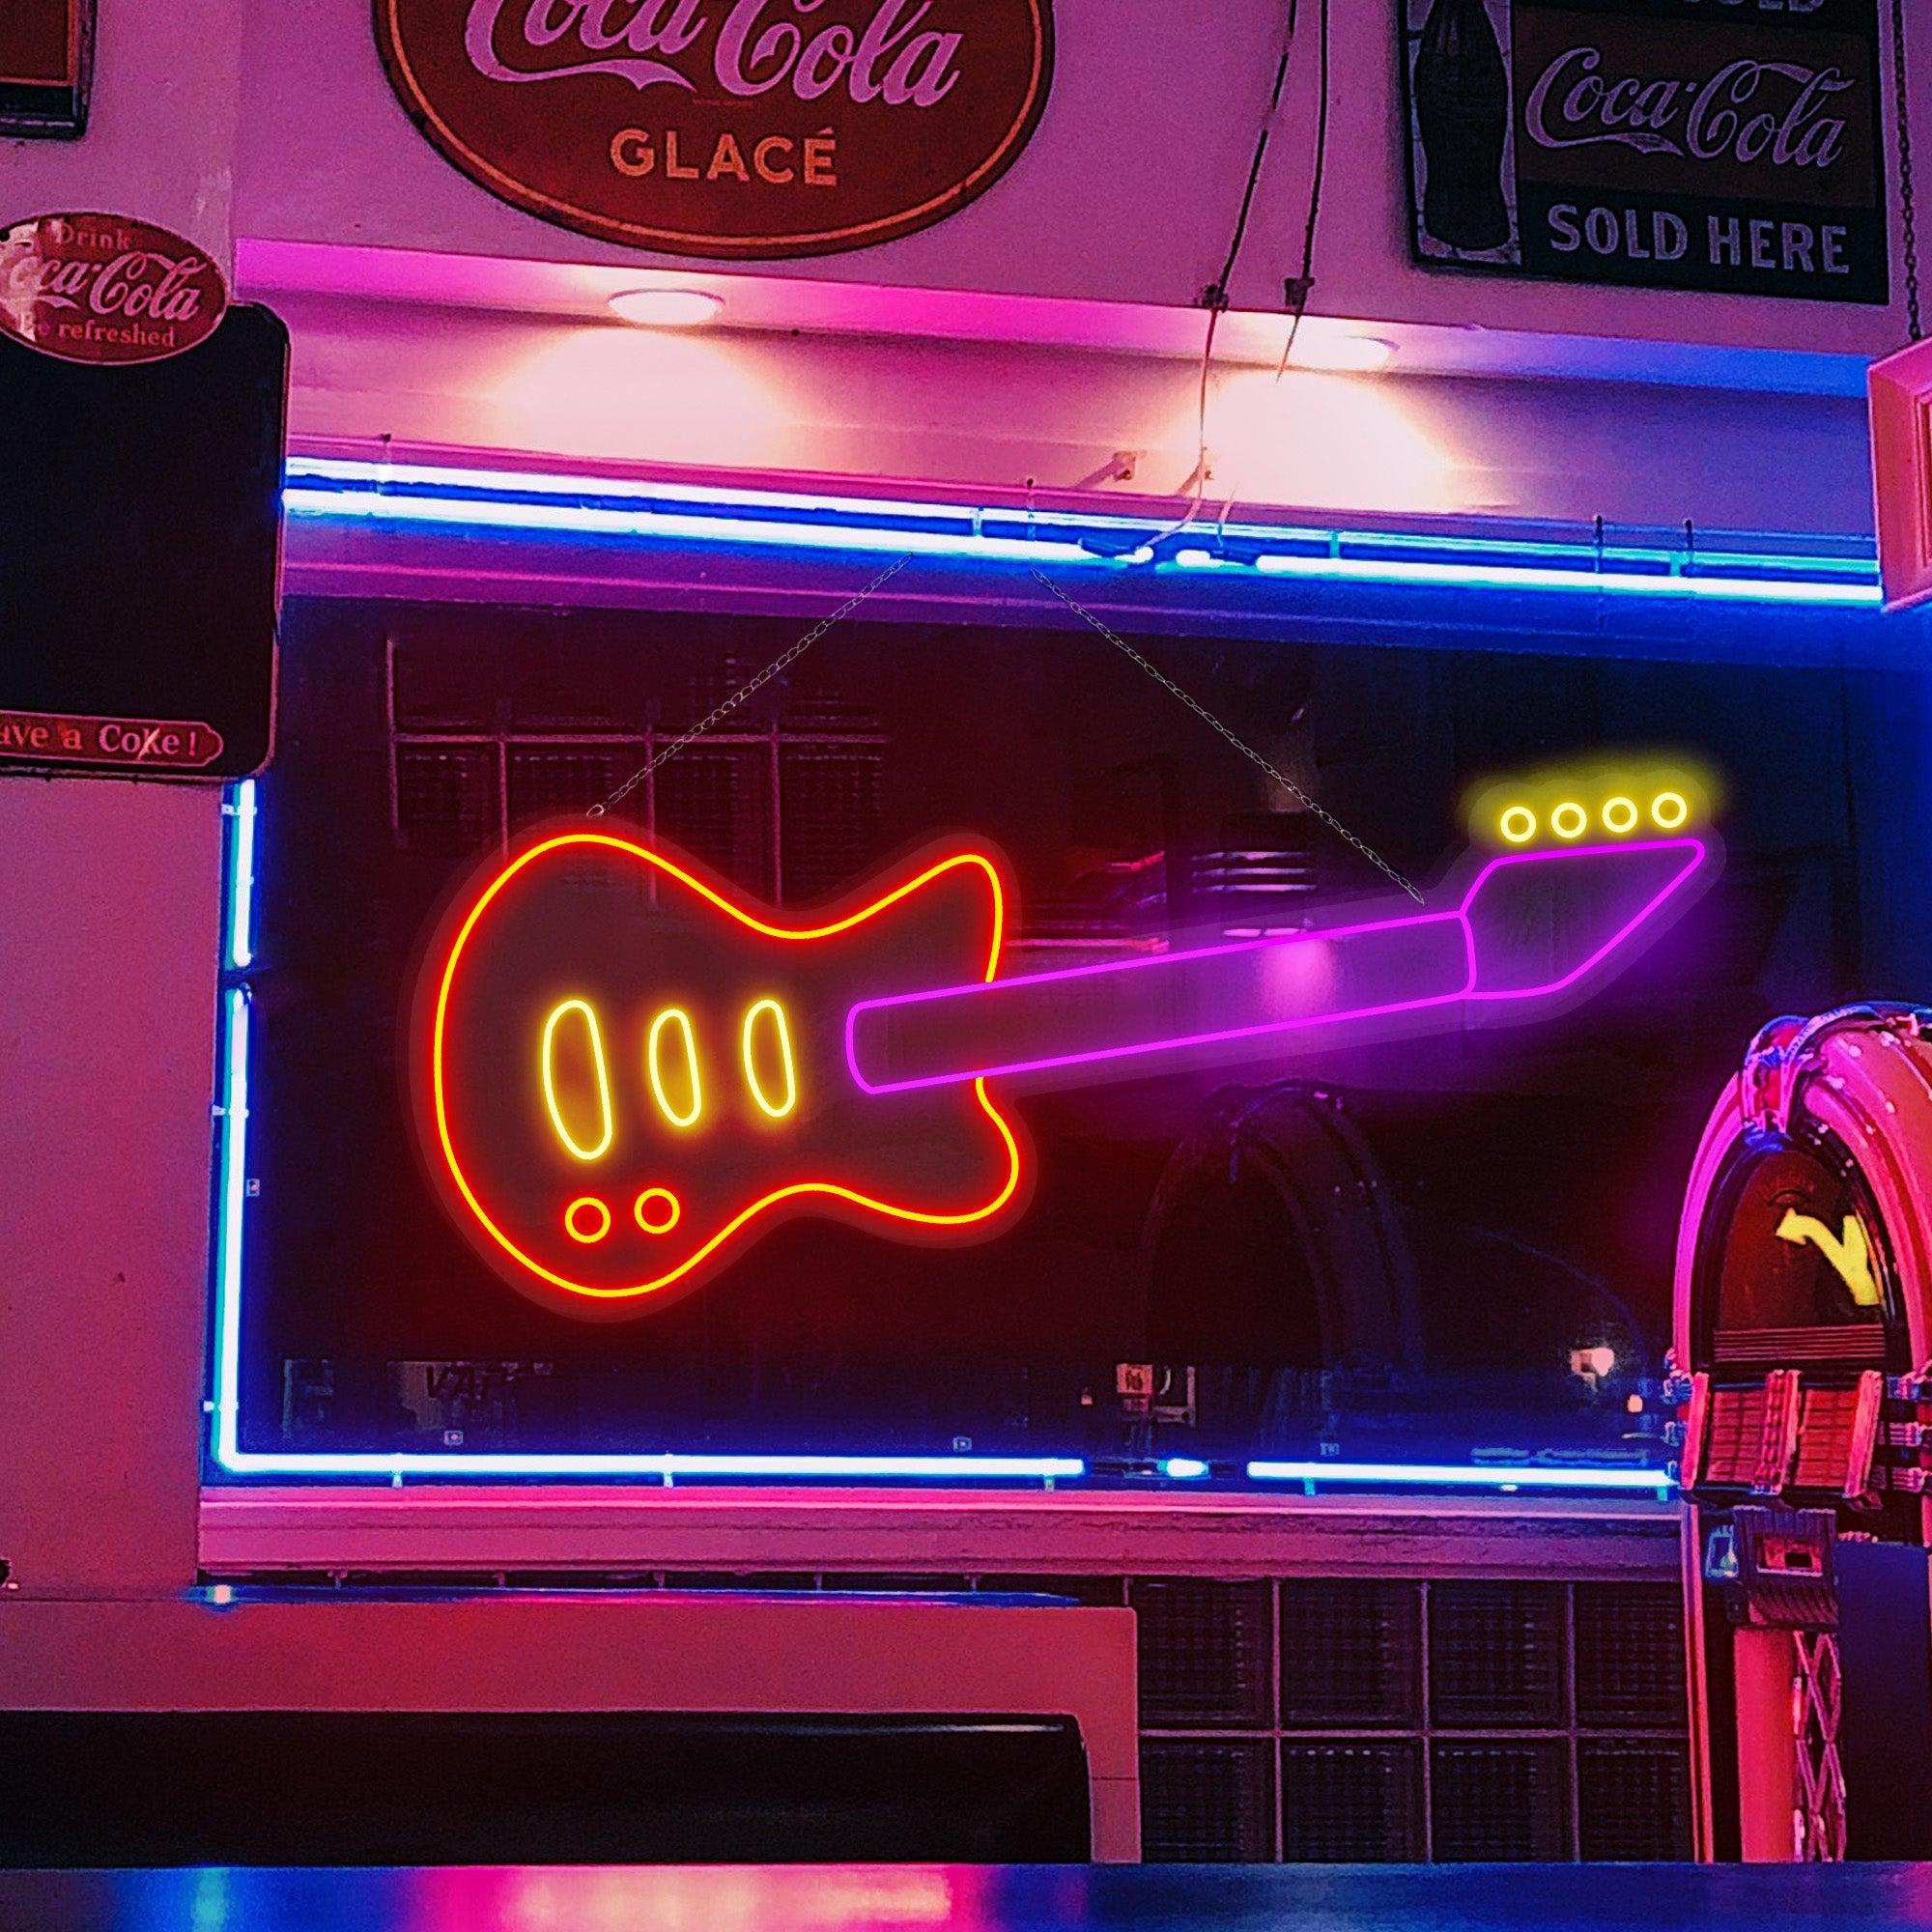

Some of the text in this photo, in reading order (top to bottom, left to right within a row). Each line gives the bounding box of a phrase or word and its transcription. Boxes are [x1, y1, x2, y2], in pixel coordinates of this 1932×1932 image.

[1524, 46, 1856, 168] Coca-Cola
[610, 127, 838, 187] GLACÉ
[55, 221, 131, 250] Drink
[1547, 203, 1851, 274] SOLD HERE
[0, 249, 207, 322] oca-Cola
[58, 319, 176, 349] refreshed
[0, 724, 48, 749] ave
[62, 729, 82, 751] a
